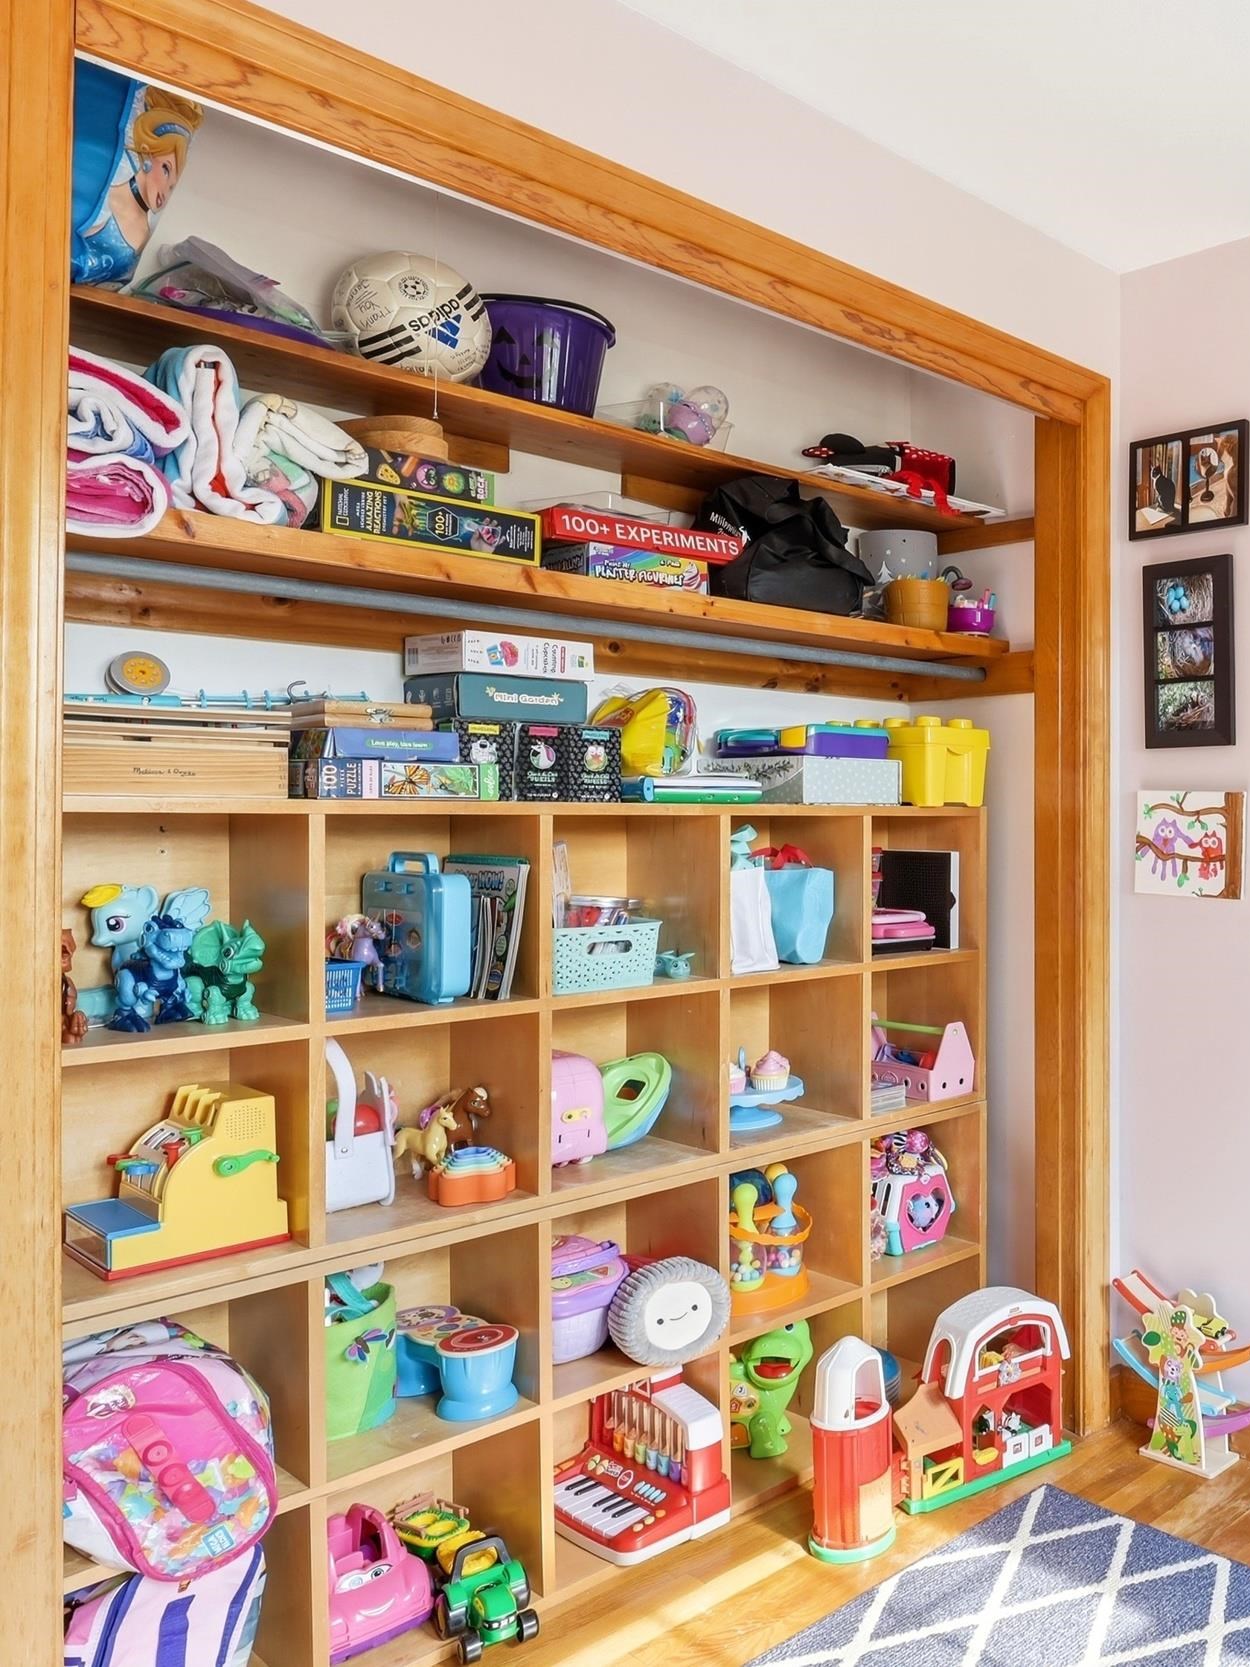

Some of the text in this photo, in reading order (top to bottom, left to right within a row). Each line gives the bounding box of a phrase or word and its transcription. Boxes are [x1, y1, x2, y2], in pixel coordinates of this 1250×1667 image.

[408, 298, 460, 332] adidas
[374, 491, 382, 534] REACTIONS
[435, 512, 445, 535] 100+
[561, 514, 739, 556] 100+ EXPERIMENTS
[595, 565, 635, 582] PLASTER
[494, 692, 559, 705] Mini Garden
[323, 765, 337, 791] 100
[347, 763, 356, 795] PUZZLE
